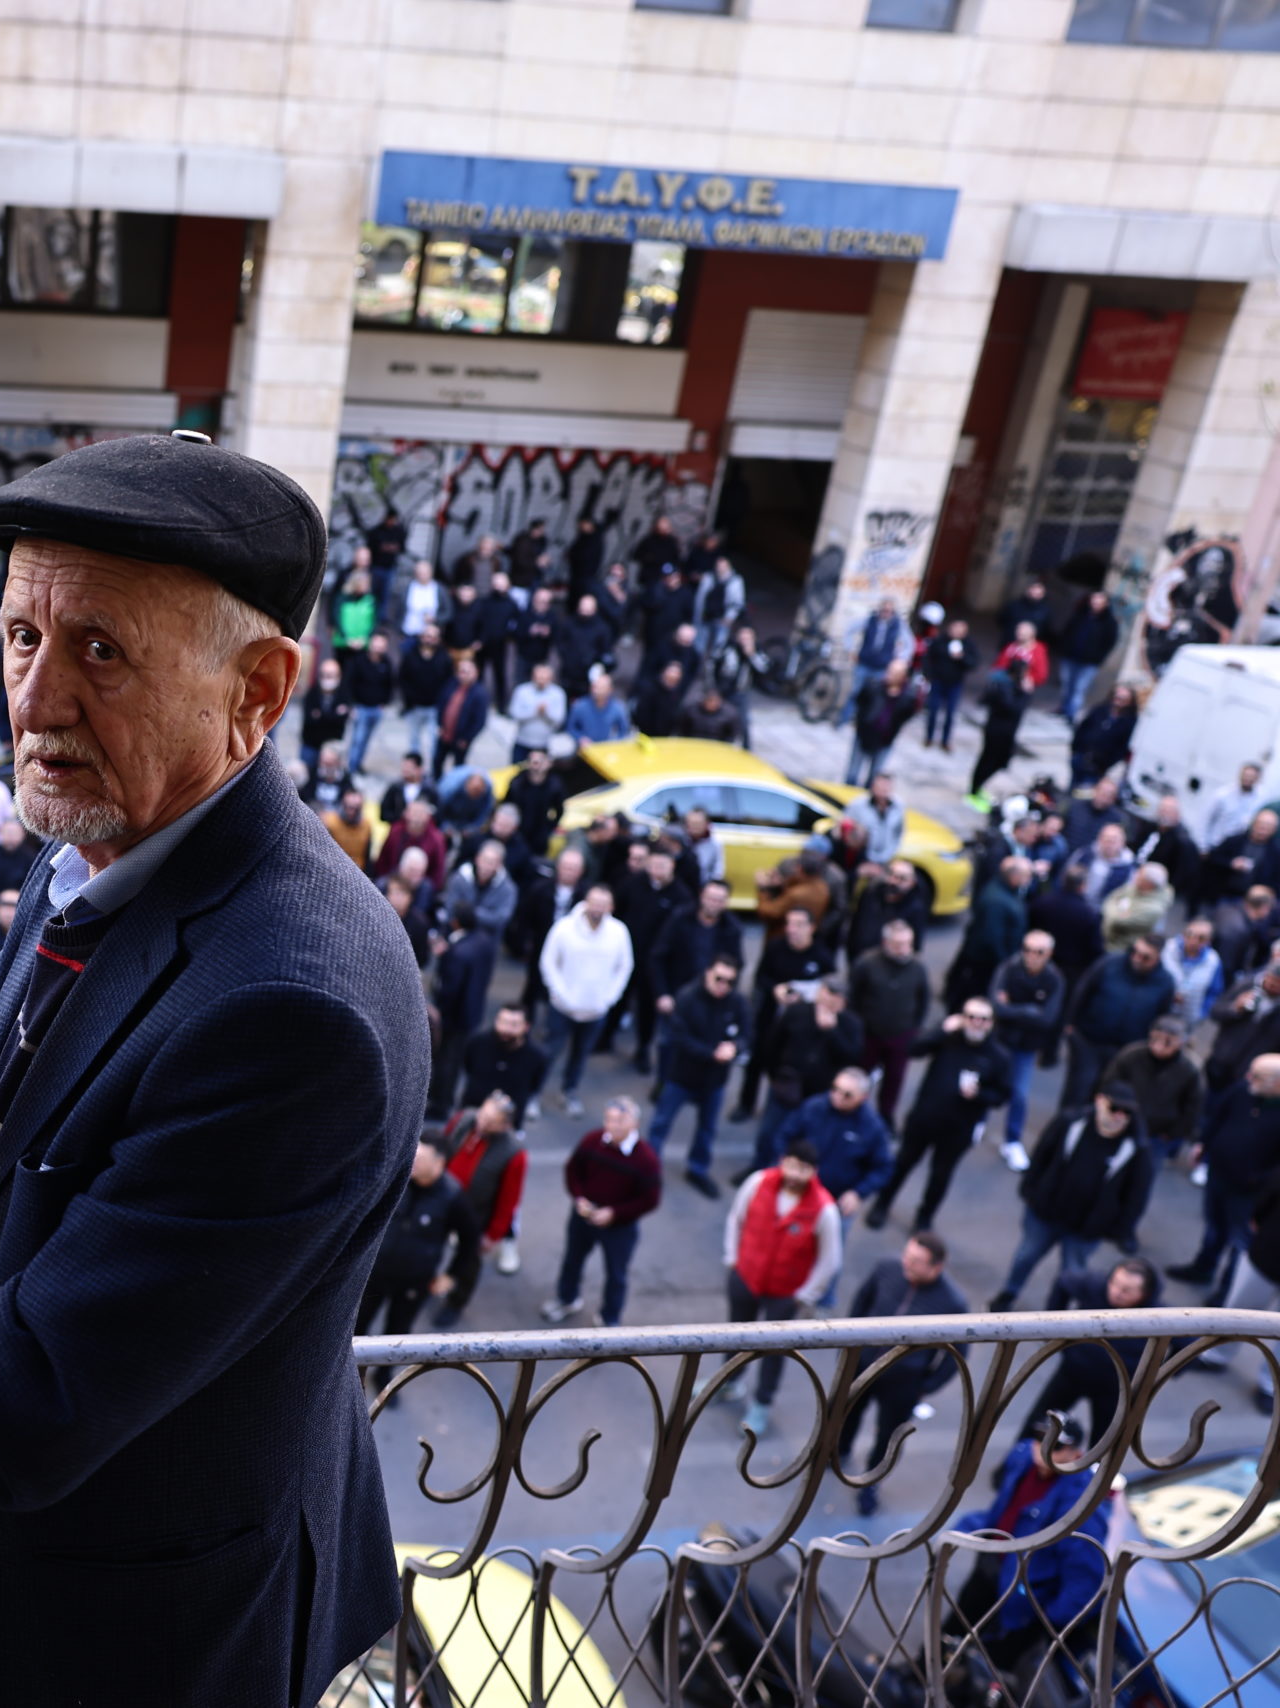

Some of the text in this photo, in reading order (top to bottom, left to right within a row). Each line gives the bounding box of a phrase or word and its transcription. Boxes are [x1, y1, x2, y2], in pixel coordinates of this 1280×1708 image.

[571, 168, 783, 215] Τ.Α.Υ.Φ.Ε.
[407, 200, 485, 228] ΤΑΜΕΙΟ
[829, 228, 923, 255] ΕΡΓΑΣΙΩΝ
